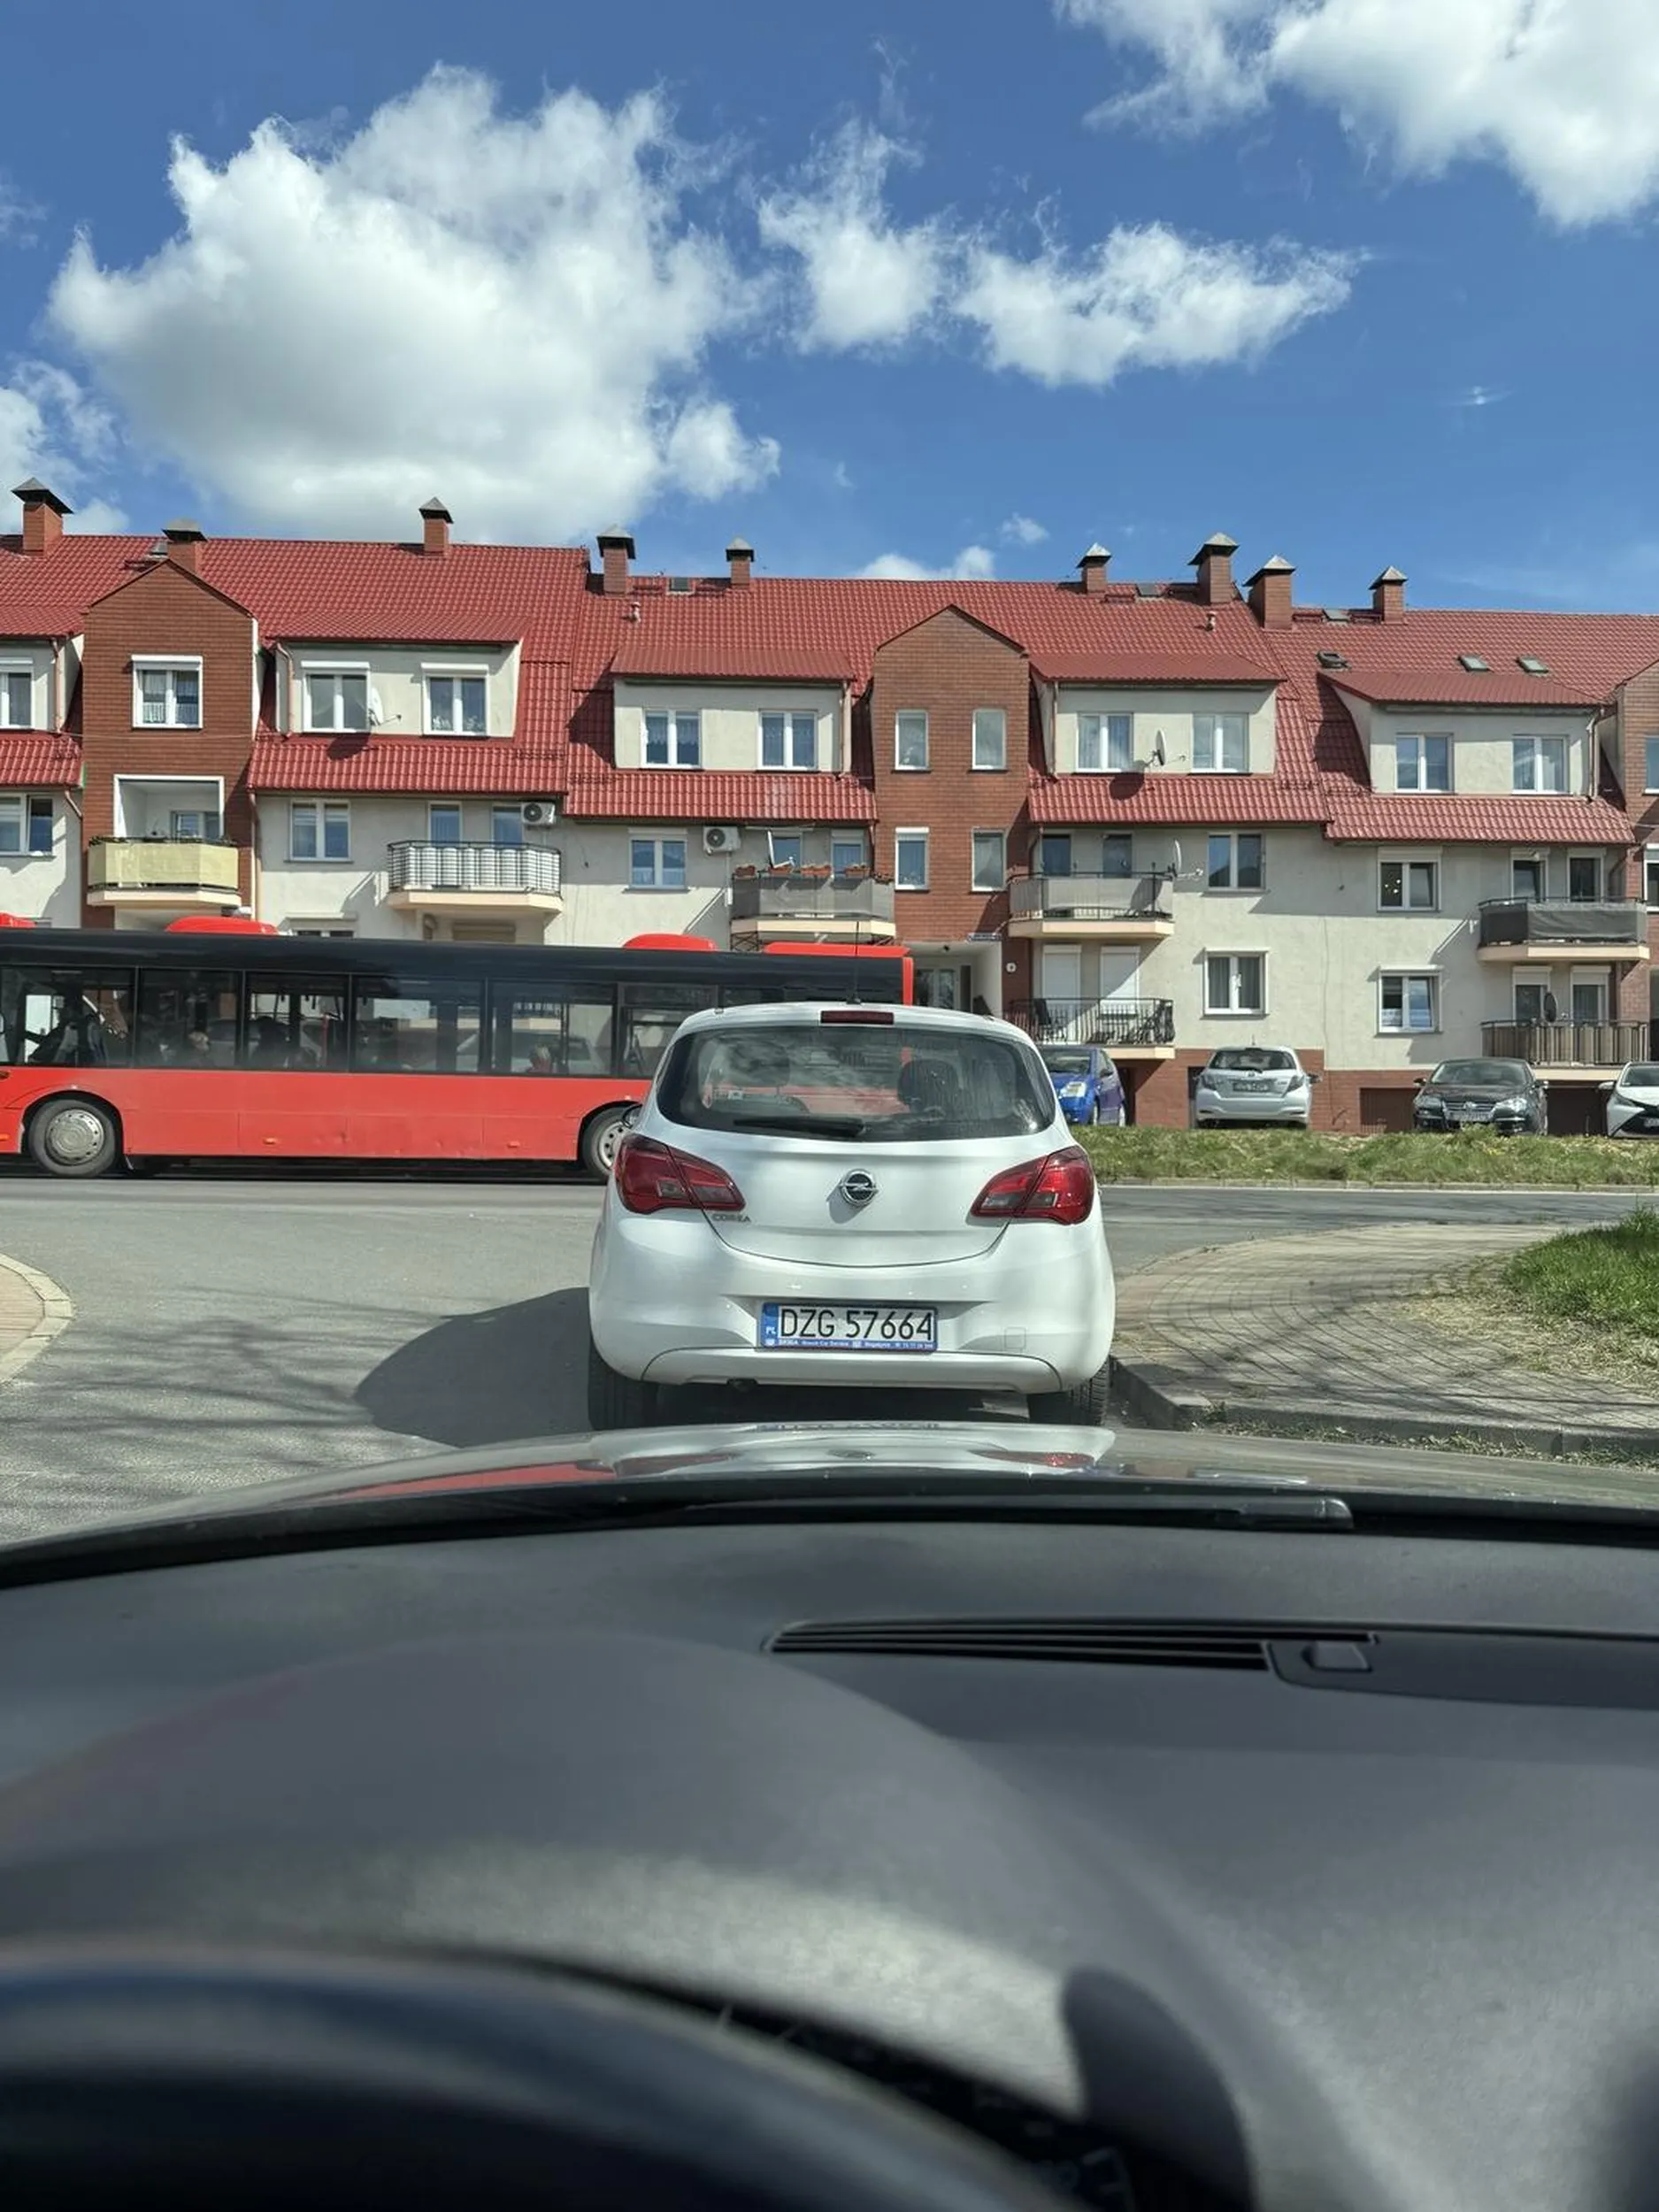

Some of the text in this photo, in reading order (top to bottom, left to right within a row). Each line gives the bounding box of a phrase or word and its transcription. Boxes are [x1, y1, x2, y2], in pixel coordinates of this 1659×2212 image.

[765, 1326, 777, 1335] PL
[780, 1308, 933, 1341] DZG 57664
